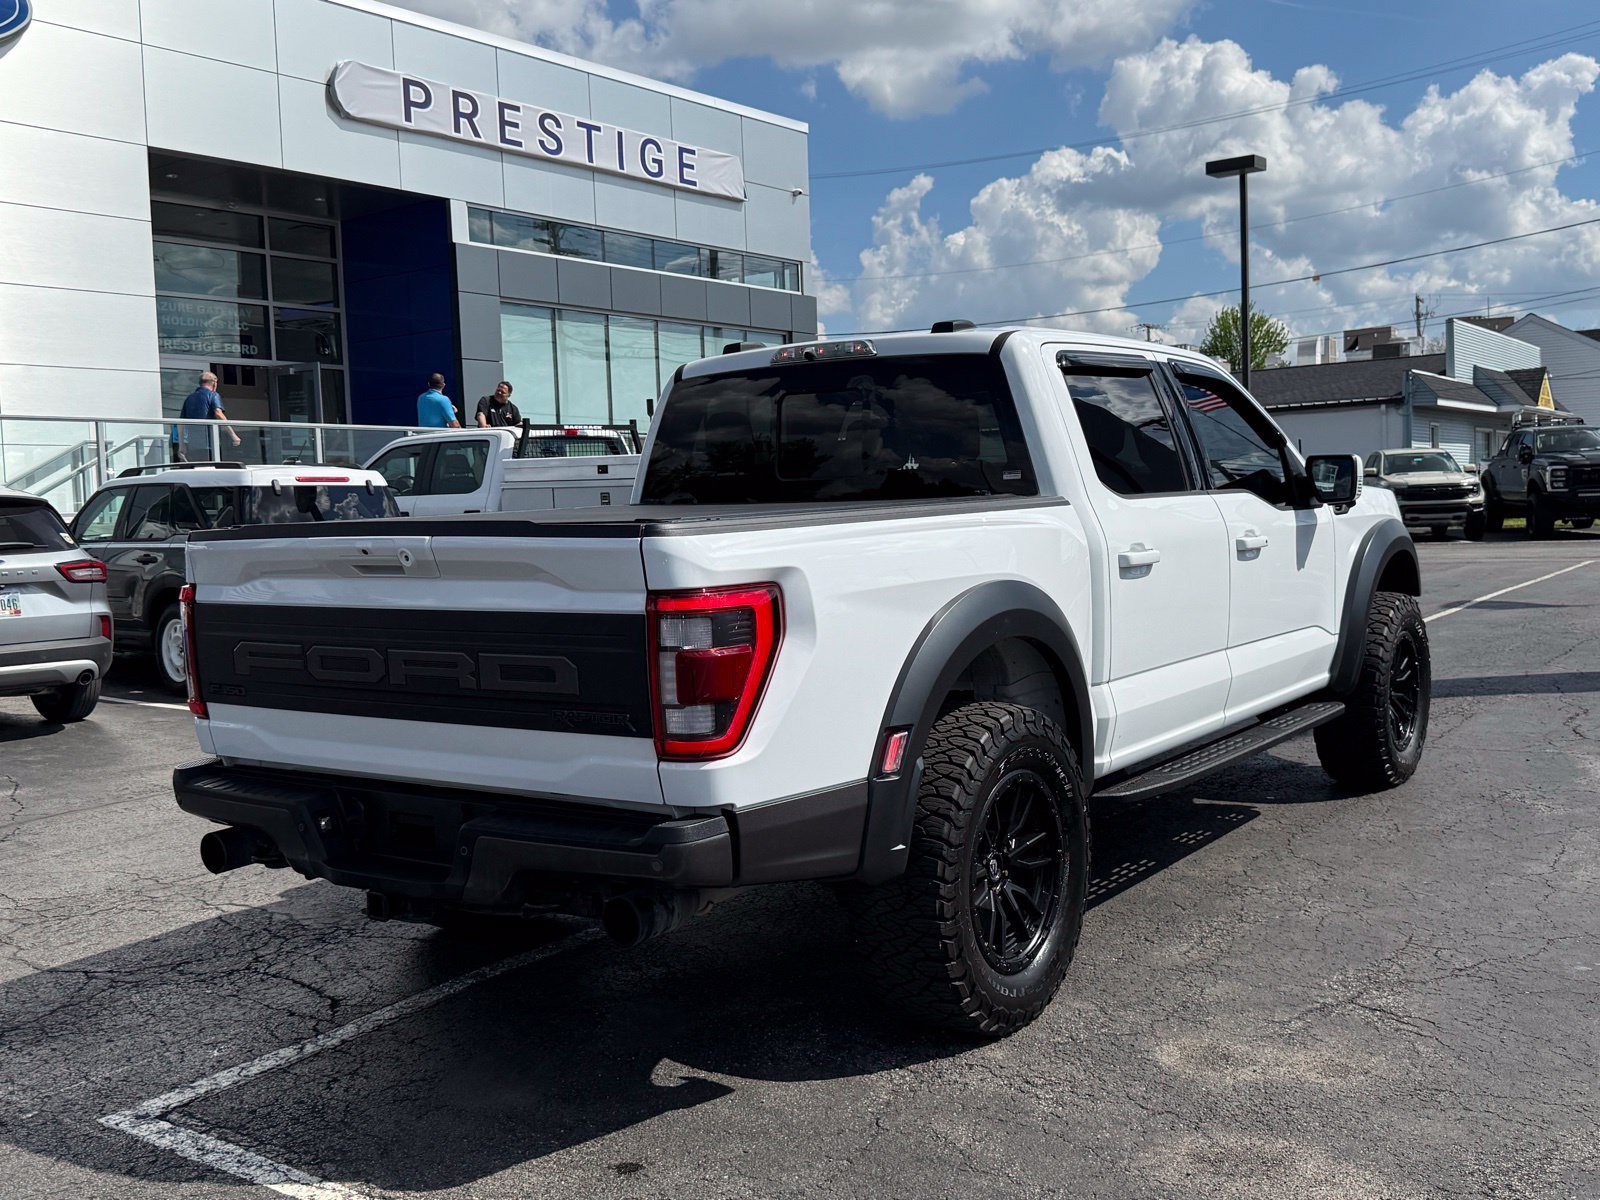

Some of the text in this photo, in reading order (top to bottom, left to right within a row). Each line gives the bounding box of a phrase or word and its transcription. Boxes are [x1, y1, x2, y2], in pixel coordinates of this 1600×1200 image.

[401, 76, 698, 187] PRESTIGE
[162, 314, 249, 331] HOLDINGS LLC
[224, 342, 259, 355] FORD
[233, 641, 580, 695] FORD
